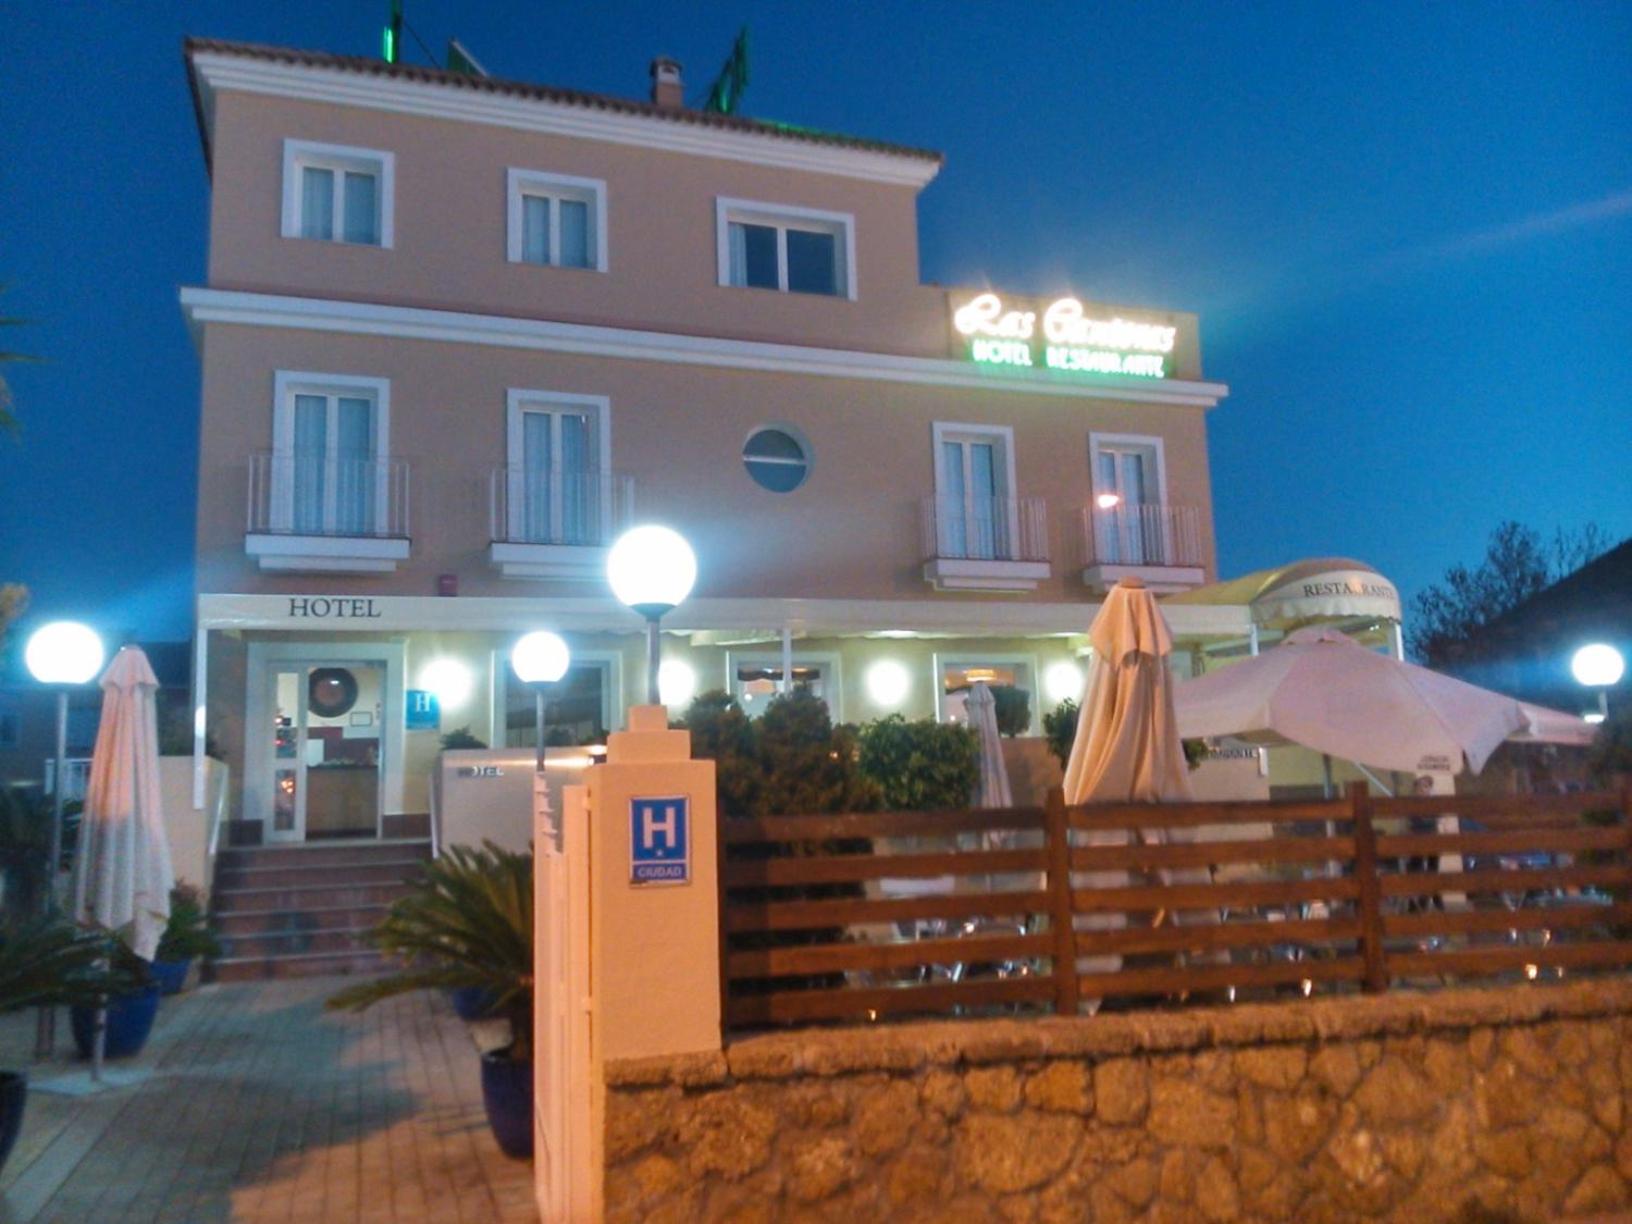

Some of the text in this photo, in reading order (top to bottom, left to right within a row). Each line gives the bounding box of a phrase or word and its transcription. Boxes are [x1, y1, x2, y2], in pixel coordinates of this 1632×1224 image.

[973, 339, 1032, 366] HOTEL
[289, 598, 382, 618] HOTEL
[643, 807, 676, 848] H
